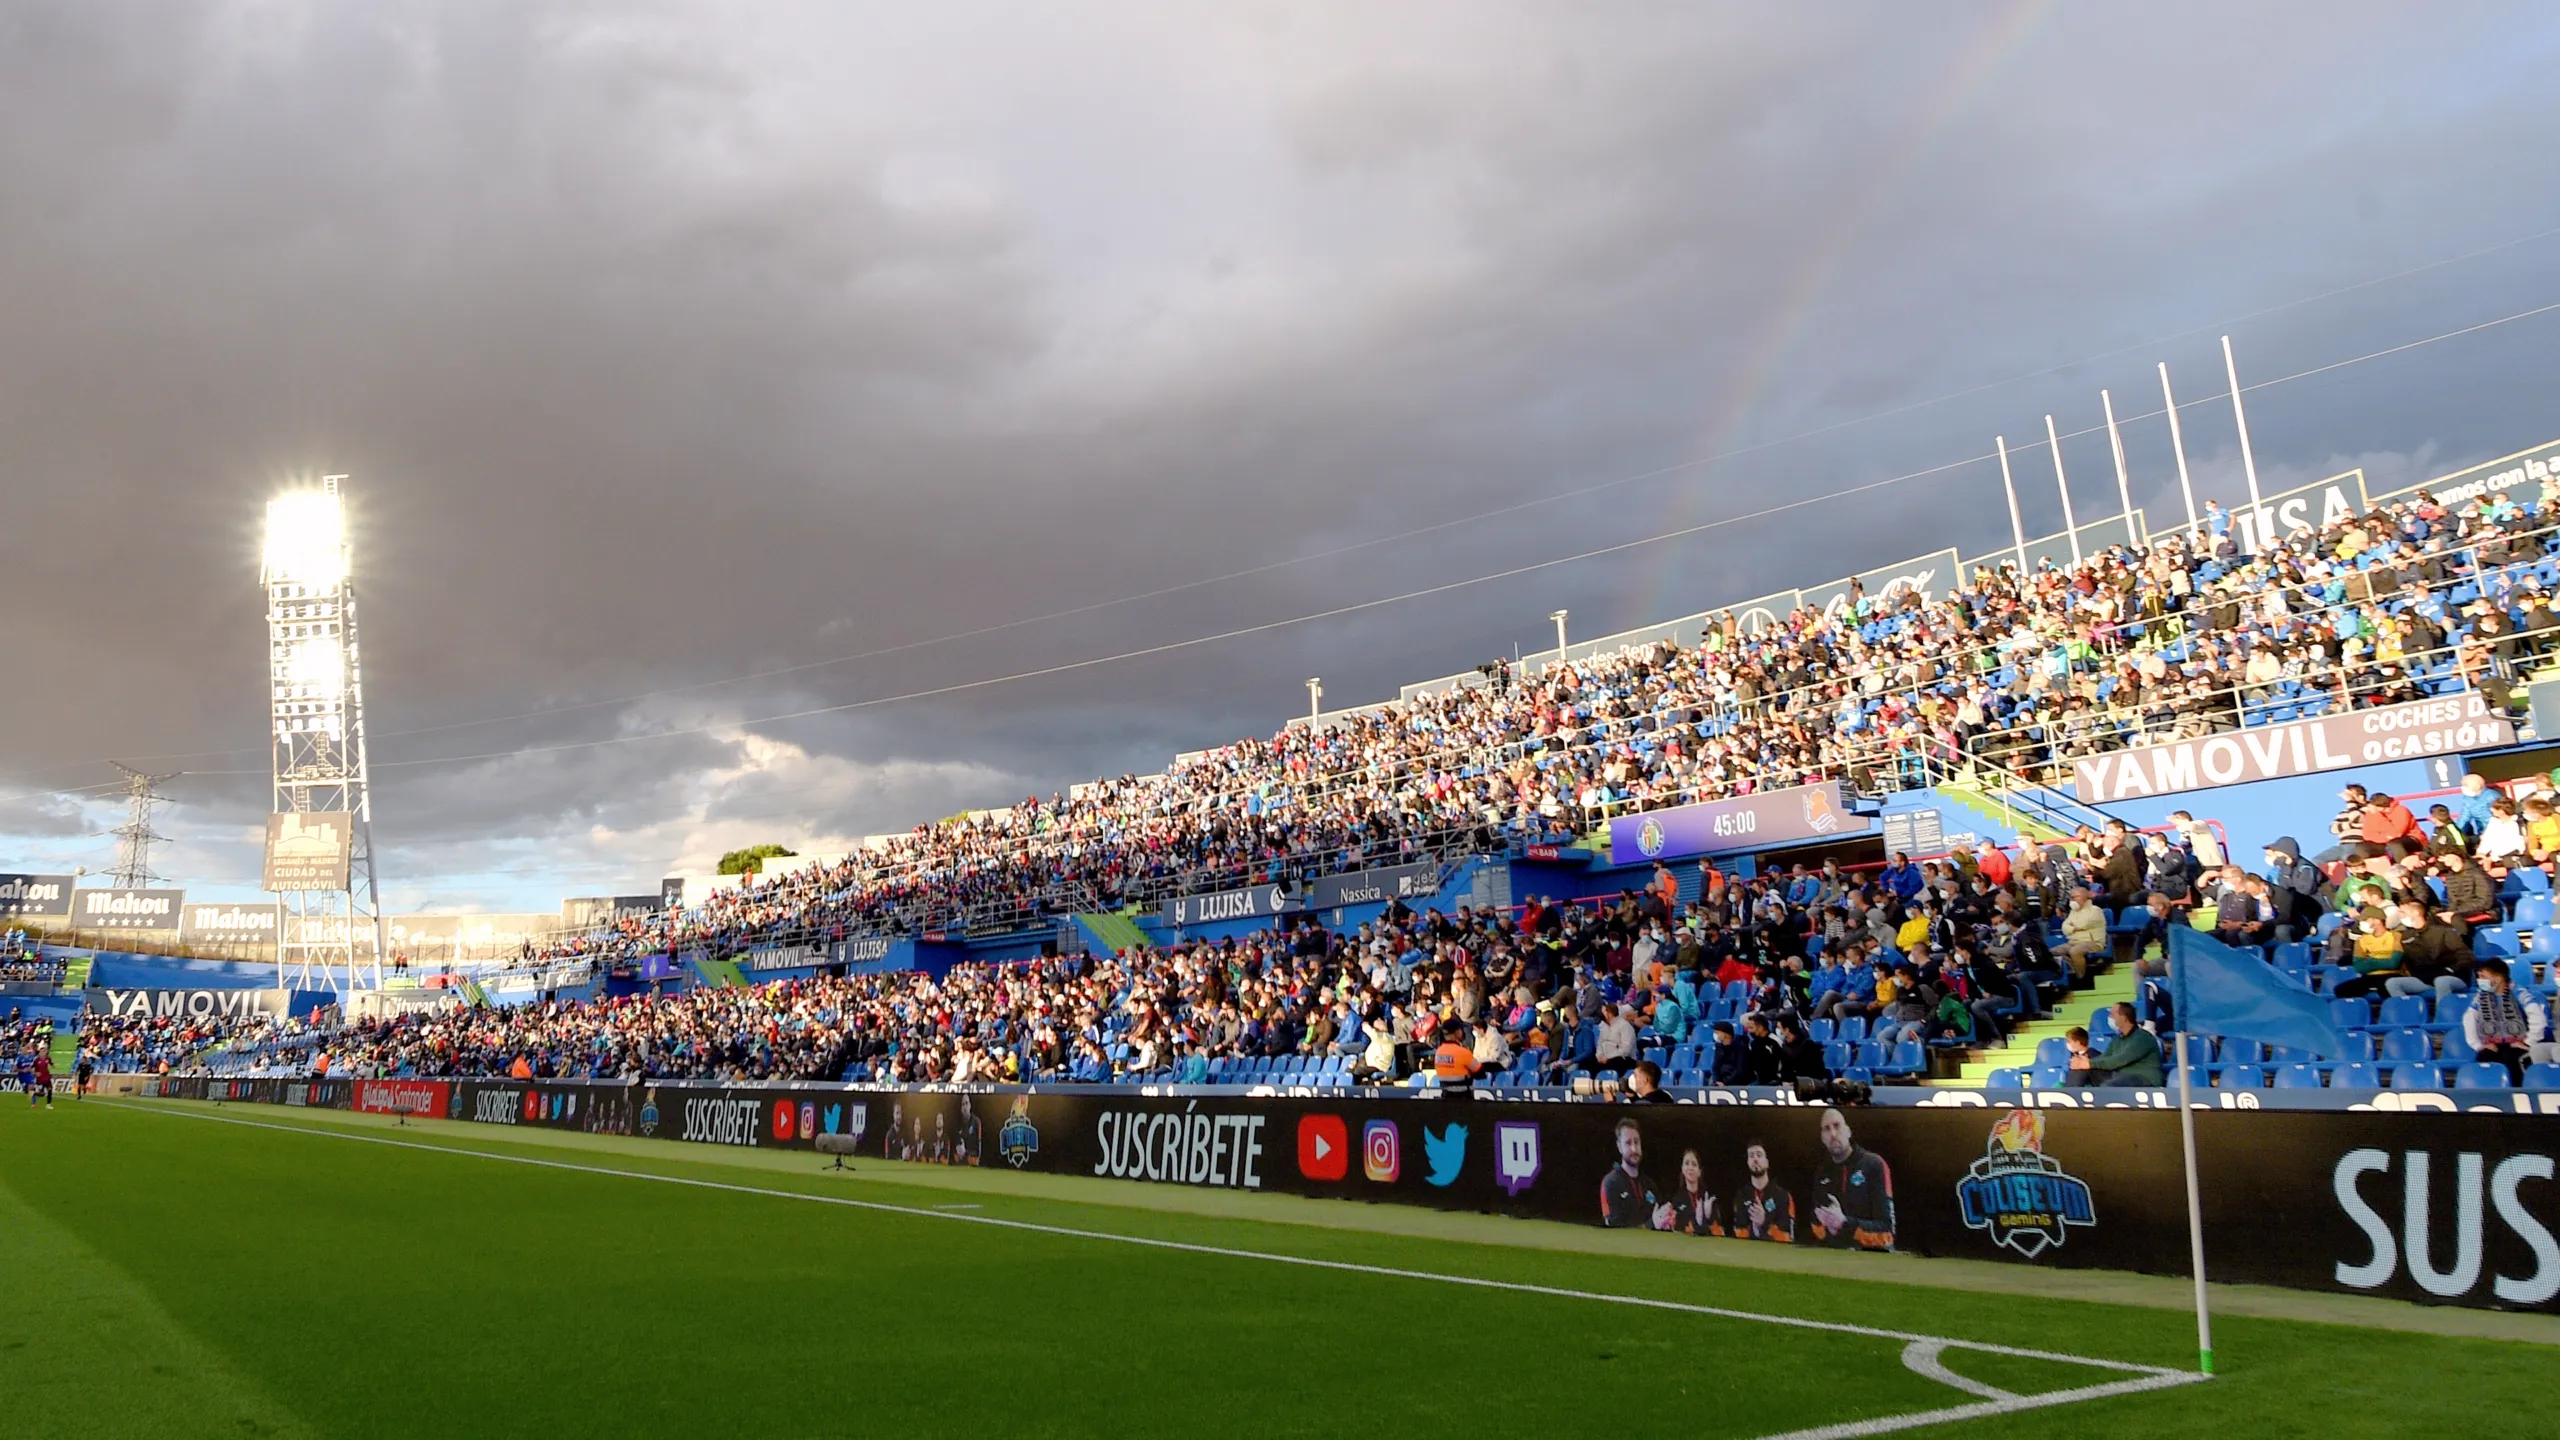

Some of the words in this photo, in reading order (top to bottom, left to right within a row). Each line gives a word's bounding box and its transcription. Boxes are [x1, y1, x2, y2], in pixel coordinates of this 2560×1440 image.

[2486, 467, 2527, 492] con
[2524, 459, 2549, 479] la
[2363, 702, 2462, 734] COCHES
[2363, 721, 2500, 761] OCASIÓN
[2076, 722, 2351, 800] YAMOVIL
[1713, 810, 1756, 837] 45:00
[270, 877, 338, 891] AUTOMÓVIL
[274, 867, 317, 877] CIUDAD
[320, 869, 334, 877] DEL
[86, 891, 170, 914] Mahou
[1340, 873, 1381, 903] Nassica
[195, 906, 275, 929] Mahou
[1199, 891, 1255, 920] LUJISA
[753, 949, 801, 971] YAMOVIL
[853, 939, 888, 960] LUJISA
[106, 991, 271, 1017] YAMOVIL
[474, 1084, 520, 1124] SUSCRÍBETE
[682, 1091, 761, 1146] SUSCRÍBETE
[1094, 1100, 1266, 1188] SUSCRÍBETE
[1962, 1174, 2090, 1224] COLISEUM
[2333, 1148, 2560, 1304] SUS
